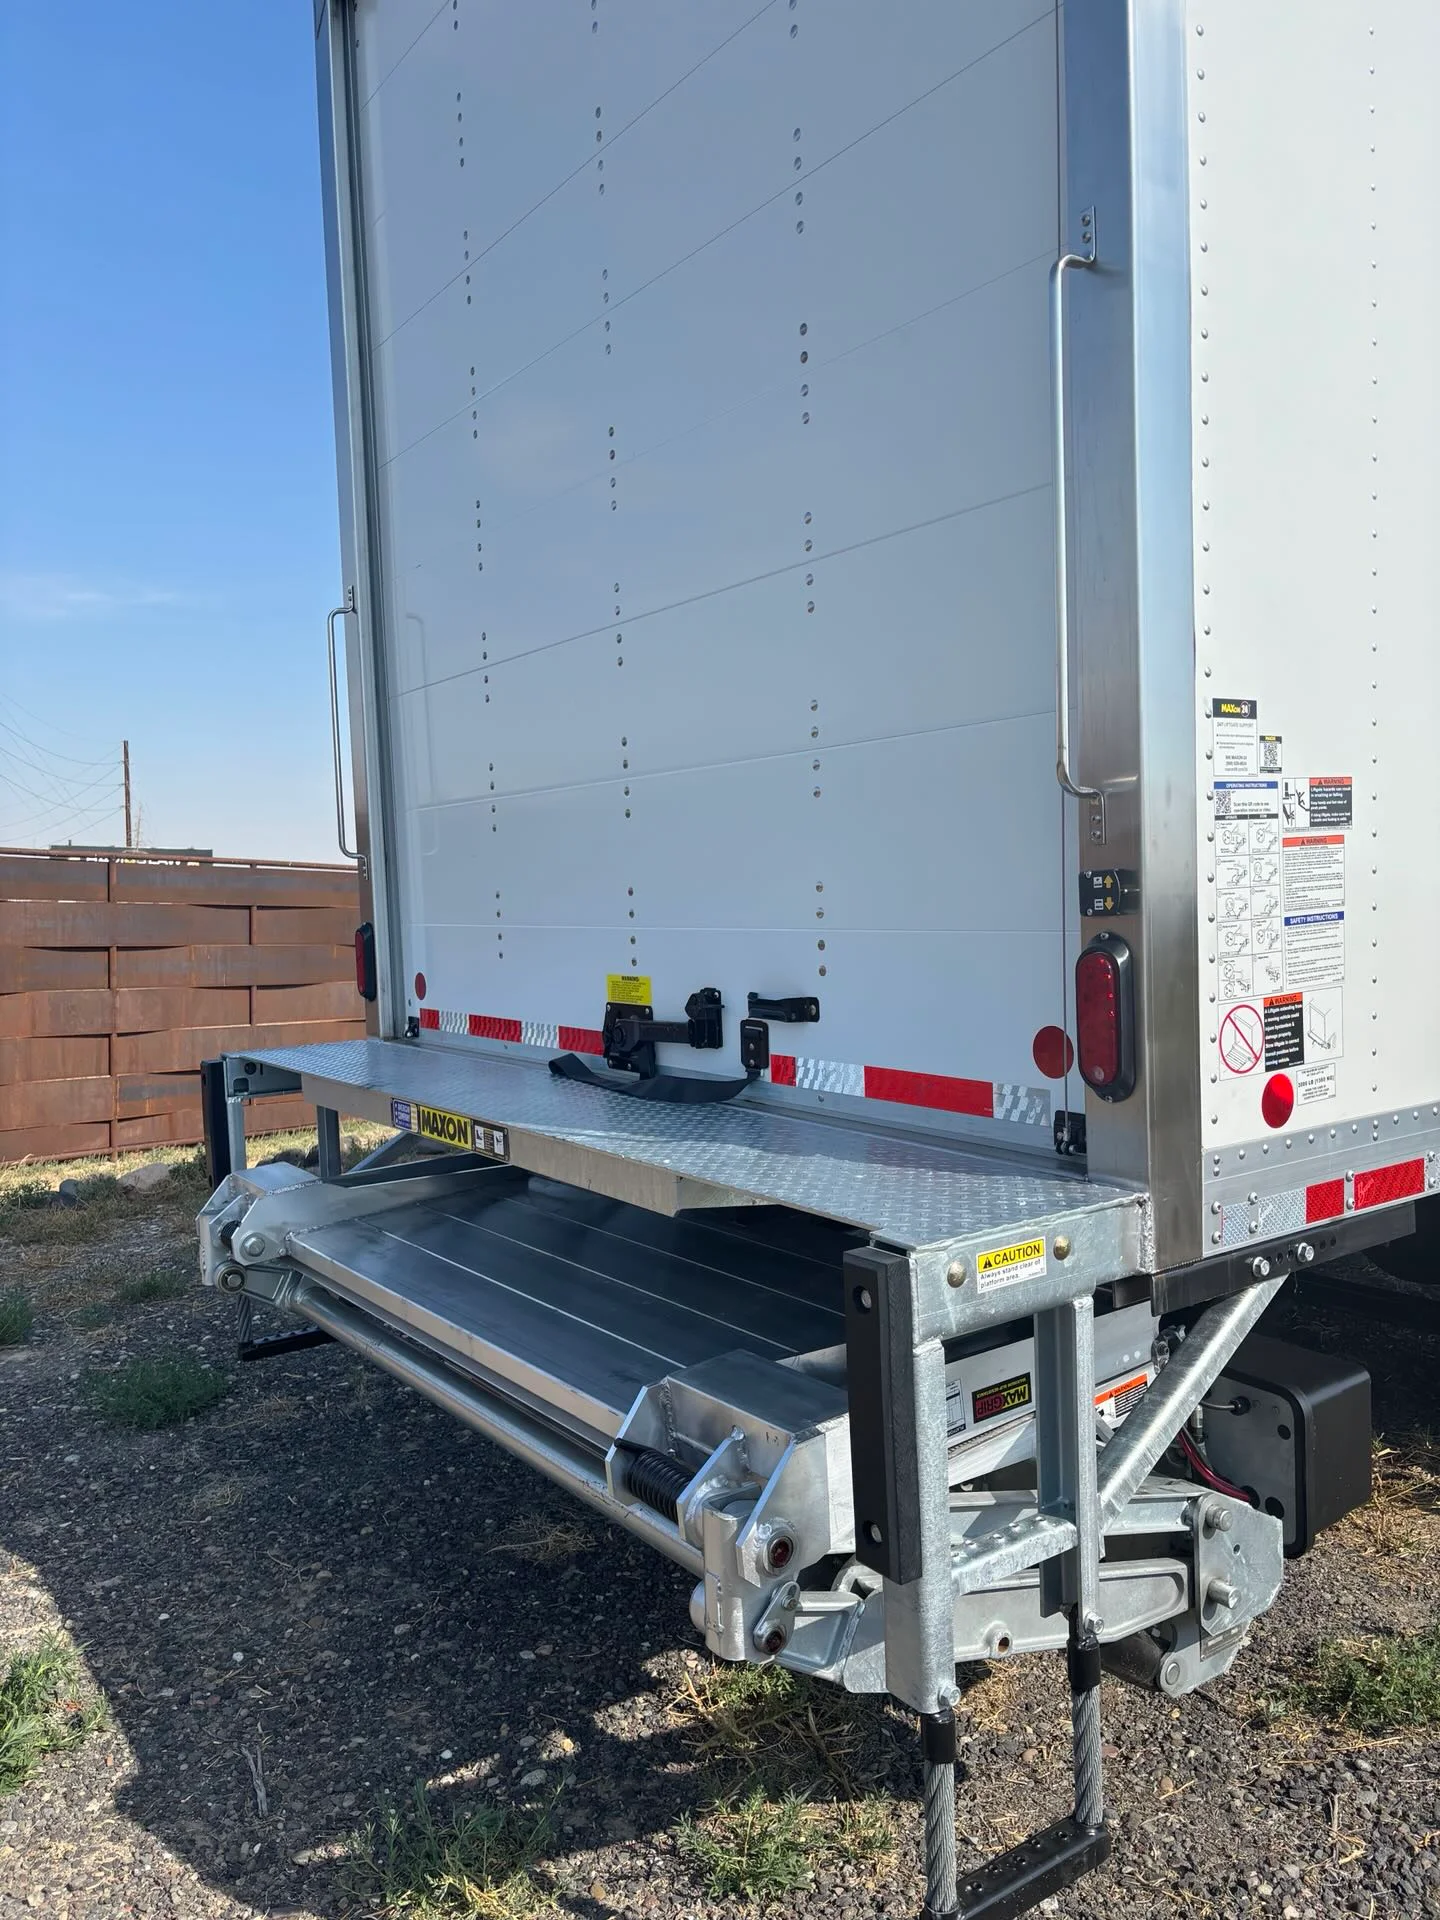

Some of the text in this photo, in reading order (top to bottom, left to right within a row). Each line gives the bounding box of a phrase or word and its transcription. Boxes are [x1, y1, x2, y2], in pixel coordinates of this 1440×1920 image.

[1290, 913, 1339, 924] SAFETY INSTRUCTIONS
[1274, 994, 1297, 1004] WARNING
[422, 1109, 469, 1145] MAXON
[994, 1243, 1040, 1265] CAUTION
[980, 1270, 1000, 1280] Always
[1002, 1265, 1018, 1274] stand
[1020, 1261, 1034, 1270] clear
[980, 1277, 1005, 1289] platform
[977, 1386, 1027, 1416] MAXGRIP
